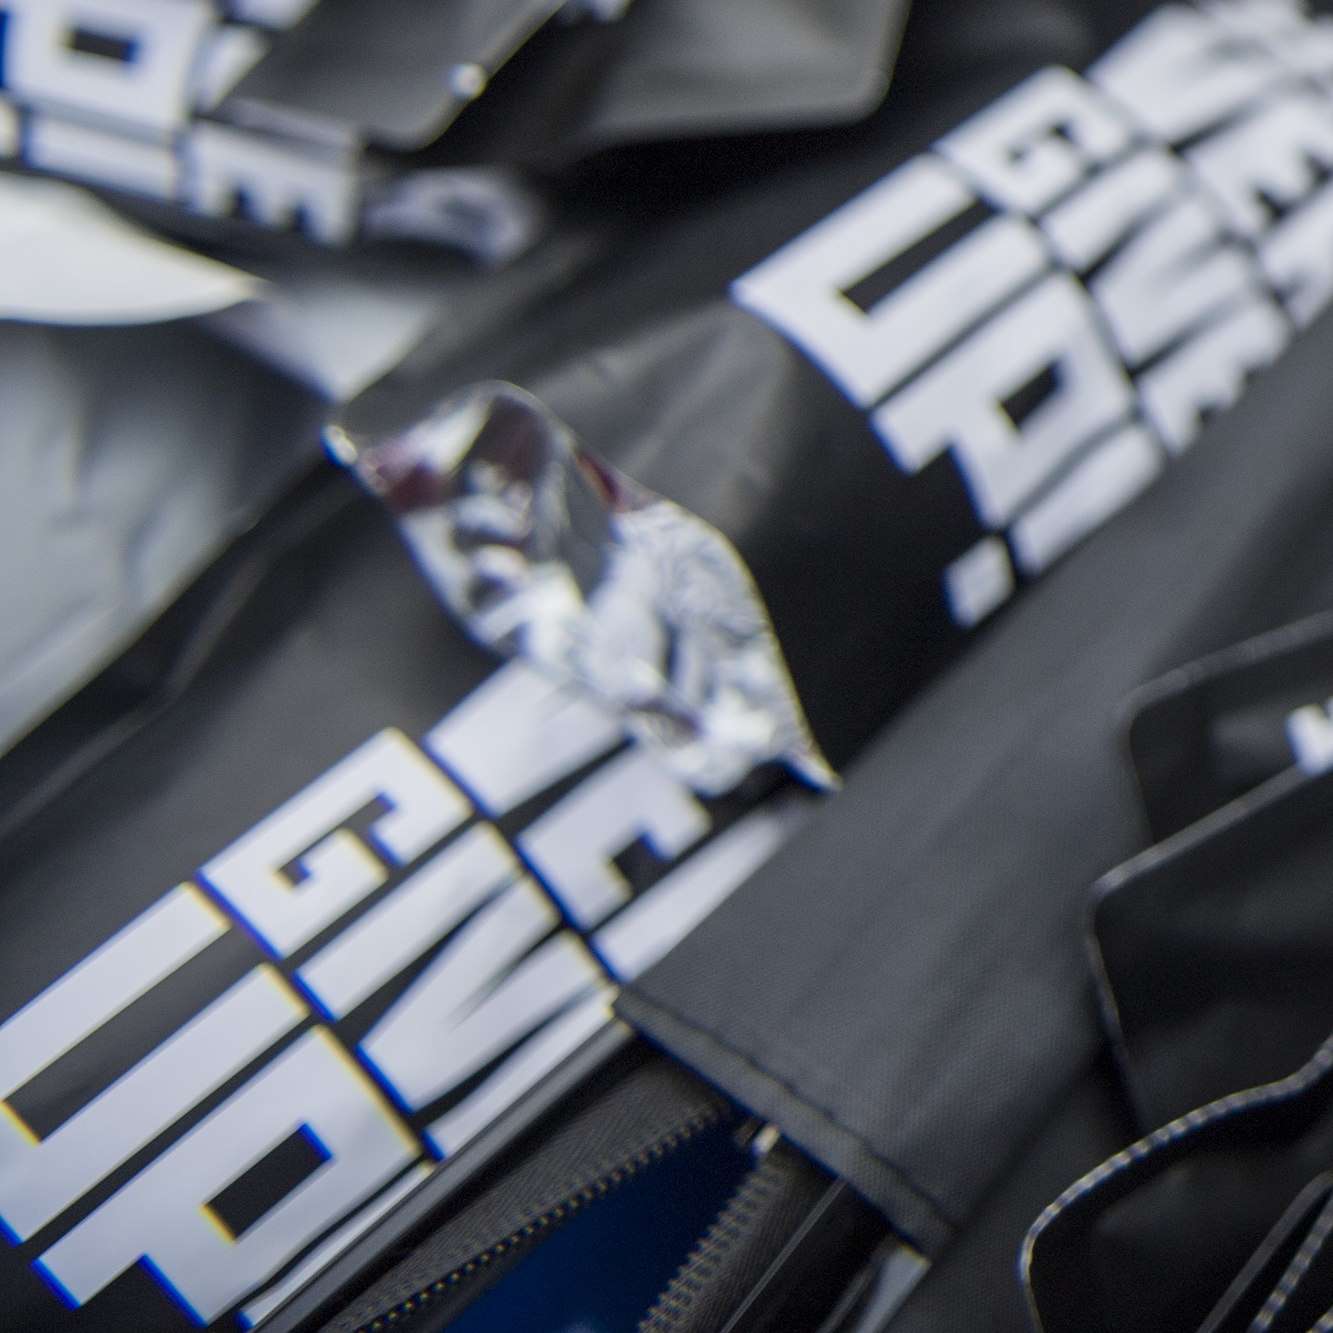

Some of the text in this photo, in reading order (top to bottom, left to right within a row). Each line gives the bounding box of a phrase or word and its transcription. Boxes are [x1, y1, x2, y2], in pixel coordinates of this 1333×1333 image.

[730, 151, 1162, 627] UP!
[934, 66, 1290, 456] GIVE
[0, 882, 436, 1330] UP
